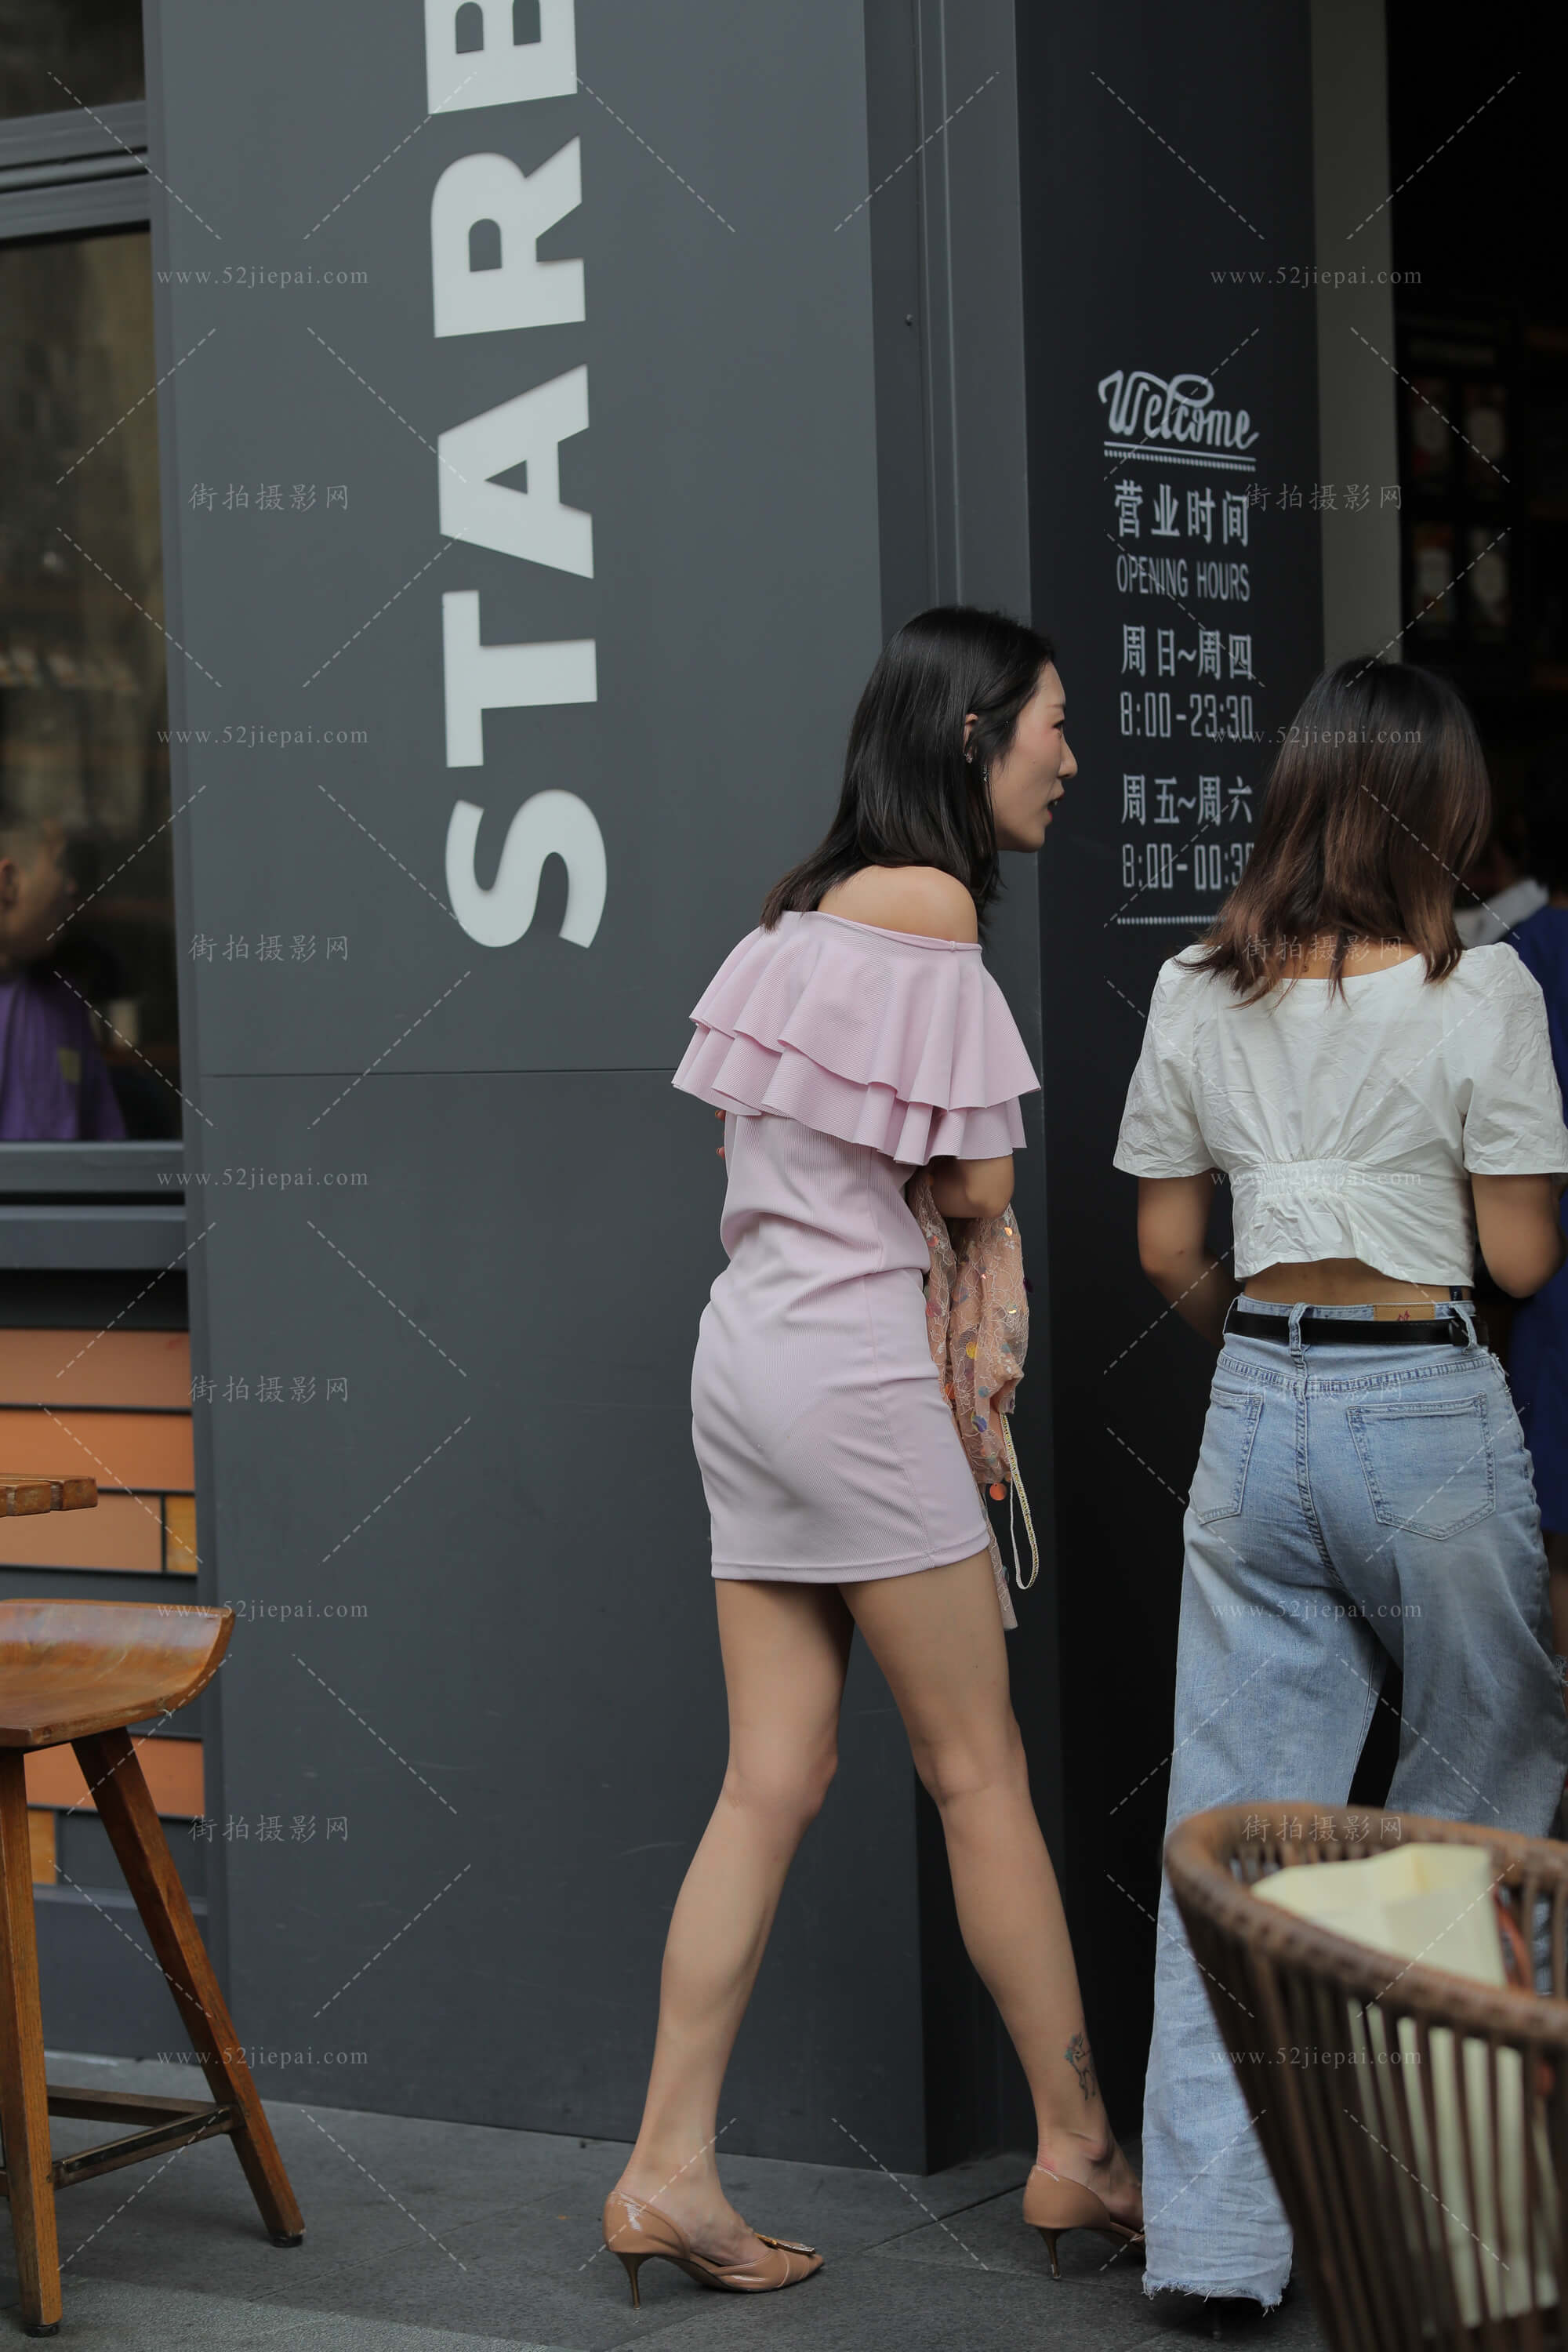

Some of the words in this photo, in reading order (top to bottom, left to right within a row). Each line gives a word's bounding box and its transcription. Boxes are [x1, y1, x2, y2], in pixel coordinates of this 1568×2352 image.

[1098, 369, 1259, 450] Welcome
[424, 0, 608, 949] STARB
[1114, 479, 1250, 547] 营业时间
[1116, 554, 1189, 597] OPENING
[1196, 560, 1250, 603] HOURS
[1120, 691, 1254, 740] 8:00-23:30
